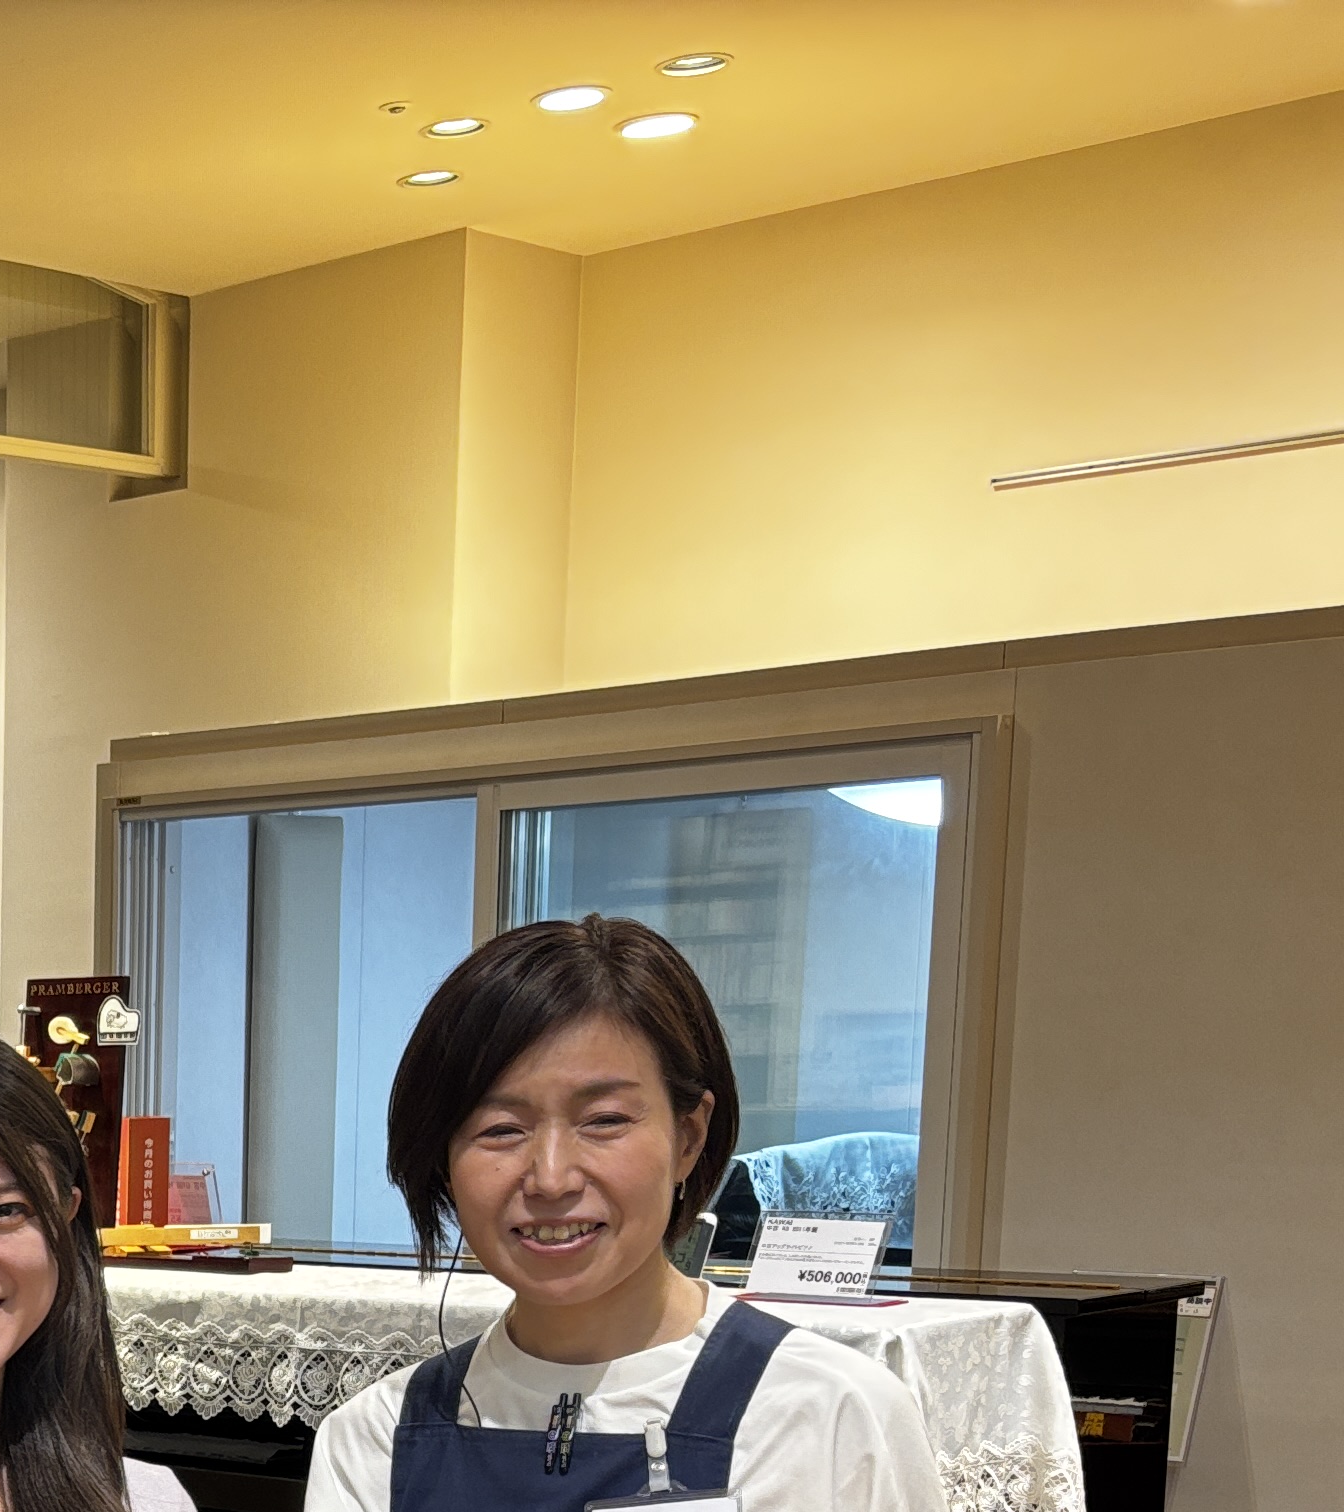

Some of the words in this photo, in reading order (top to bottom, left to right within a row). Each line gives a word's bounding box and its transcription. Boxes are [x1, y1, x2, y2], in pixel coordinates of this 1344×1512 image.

[30, 981, 120, 997] PRAMBERGER
[143, 1137, 154, 1224] 今月のお買い得商
[797, 1269, 862, 1285] ¥506,000
